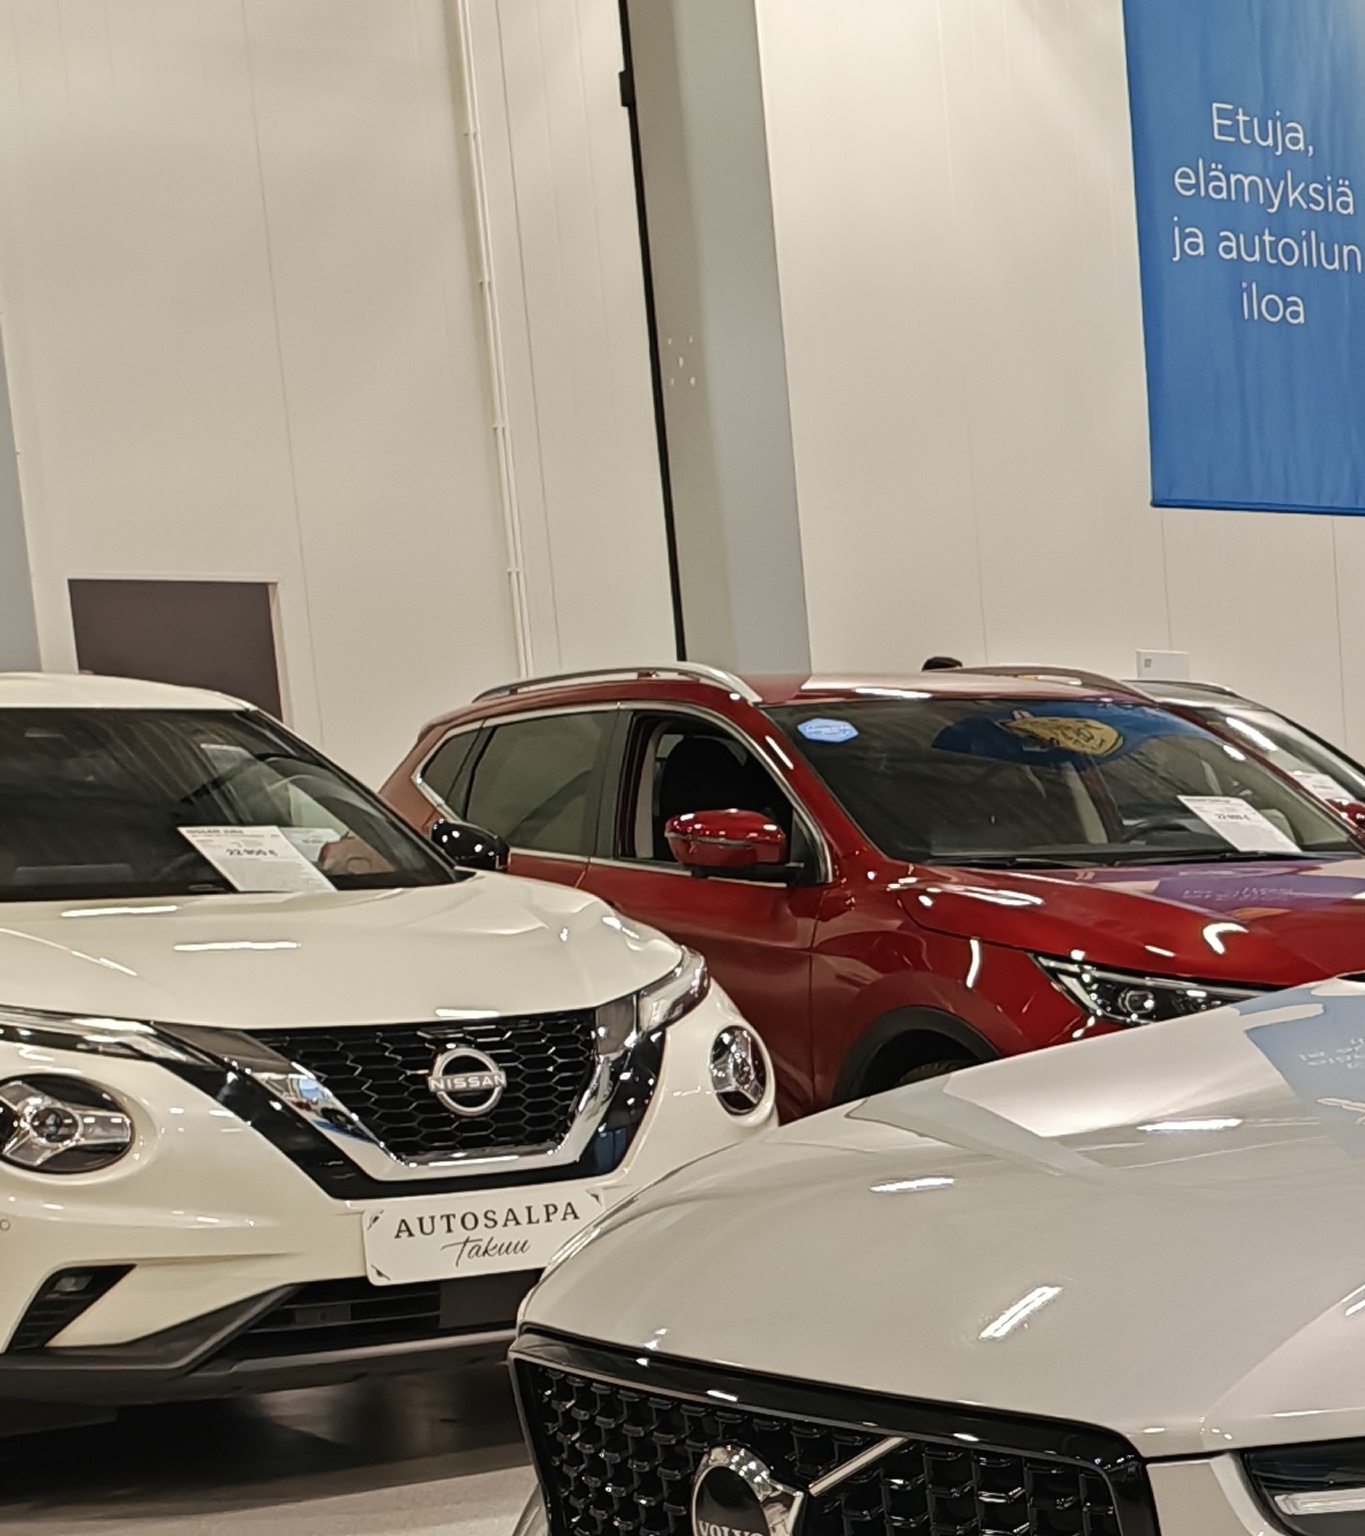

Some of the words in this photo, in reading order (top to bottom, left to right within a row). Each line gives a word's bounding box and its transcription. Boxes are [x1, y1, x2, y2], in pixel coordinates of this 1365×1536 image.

[1211, 102, 1314, 156] Etuja,
[1173, 157, 1355, 215] elämyksiä
[1172, 216, 1205, 262] ja
[1217, 227, 1363, 273] autoilun
[1241, 281, 1306, 324] iloa
[430, 1074, 507, 1091] NISSAN
[394, 1201, 581, 1239] AUTOSALPA
[440, 1236, 531, 1268] Takuu
